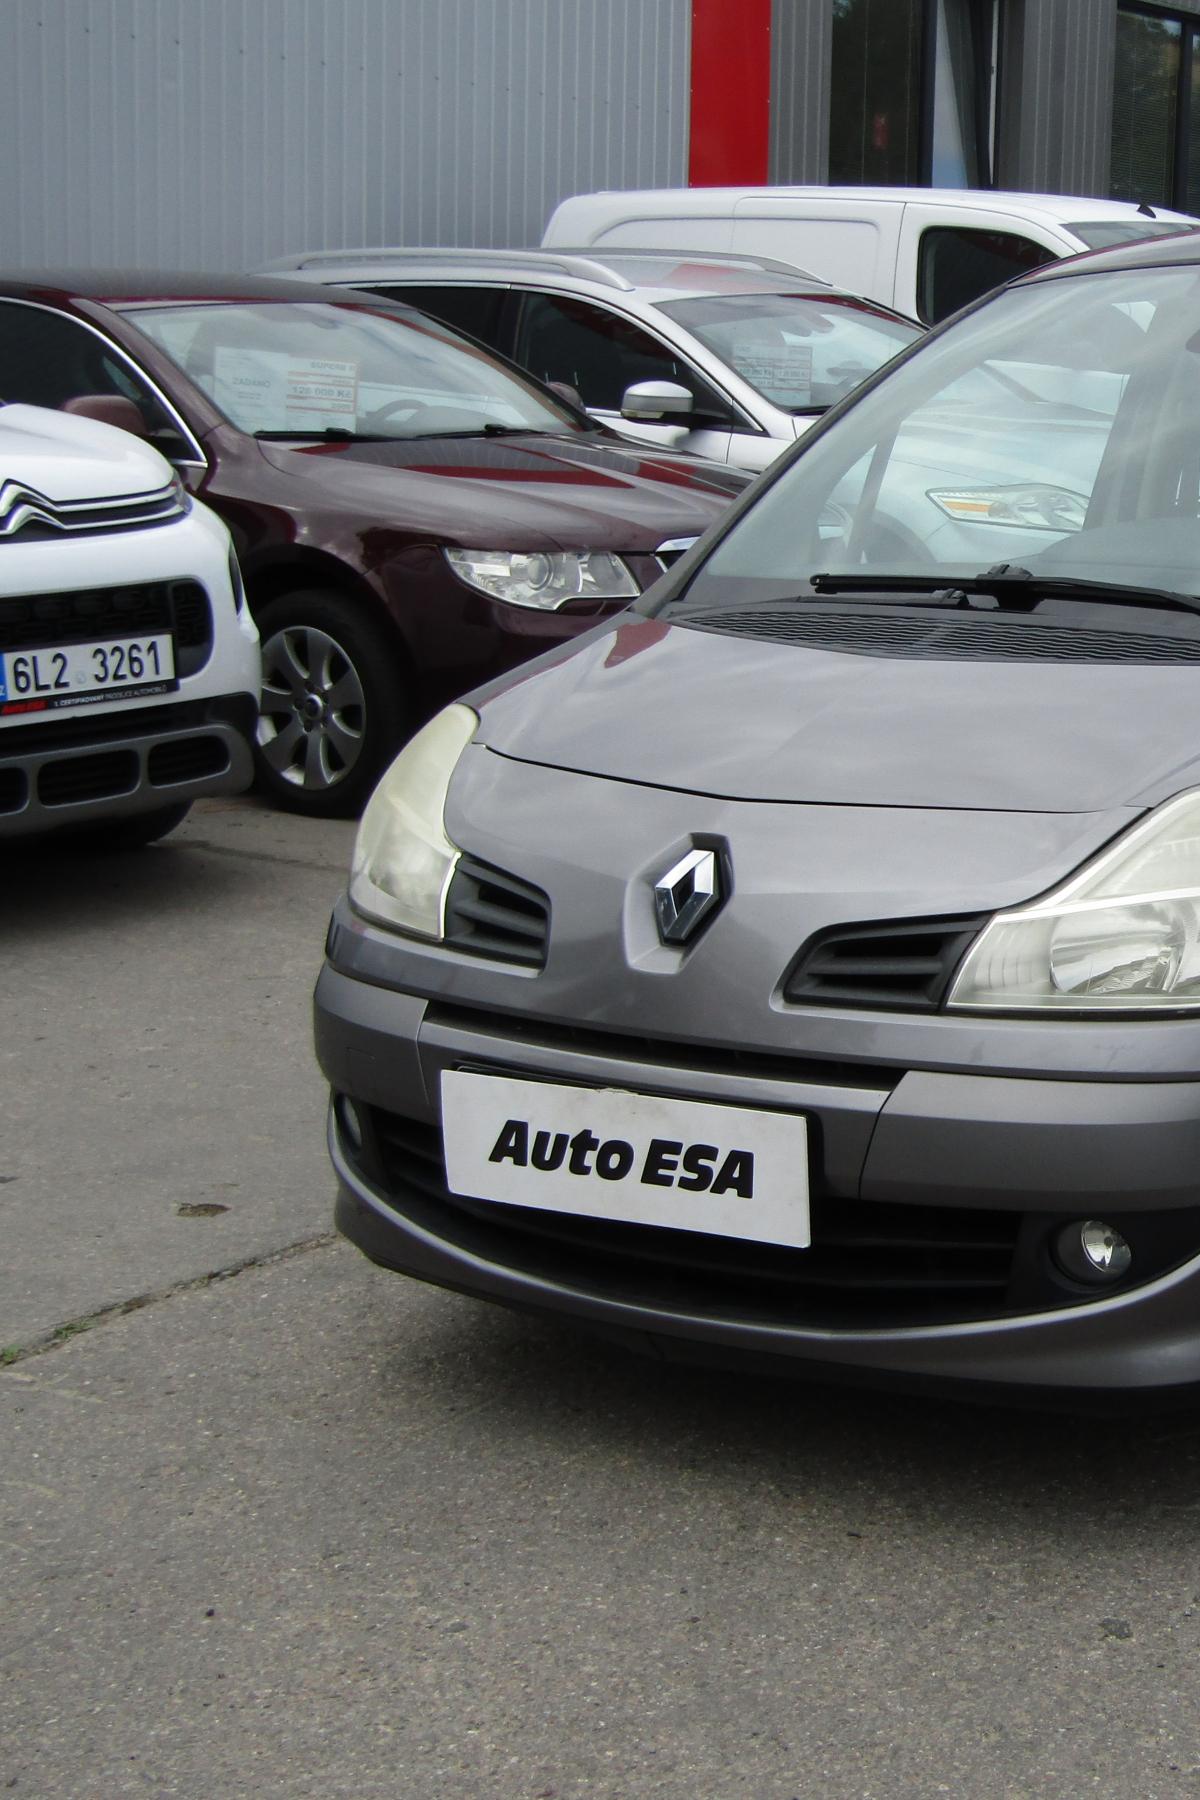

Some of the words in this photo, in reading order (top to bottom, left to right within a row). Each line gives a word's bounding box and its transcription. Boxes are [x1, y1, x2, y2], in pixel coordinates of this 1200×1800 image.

[13, 653, 70, 694] 6L2
[92, 640, 160, 683] 3261
[488, 1119, 635, 1181] Auto
[640, 1138, 755, 1200] ESA
